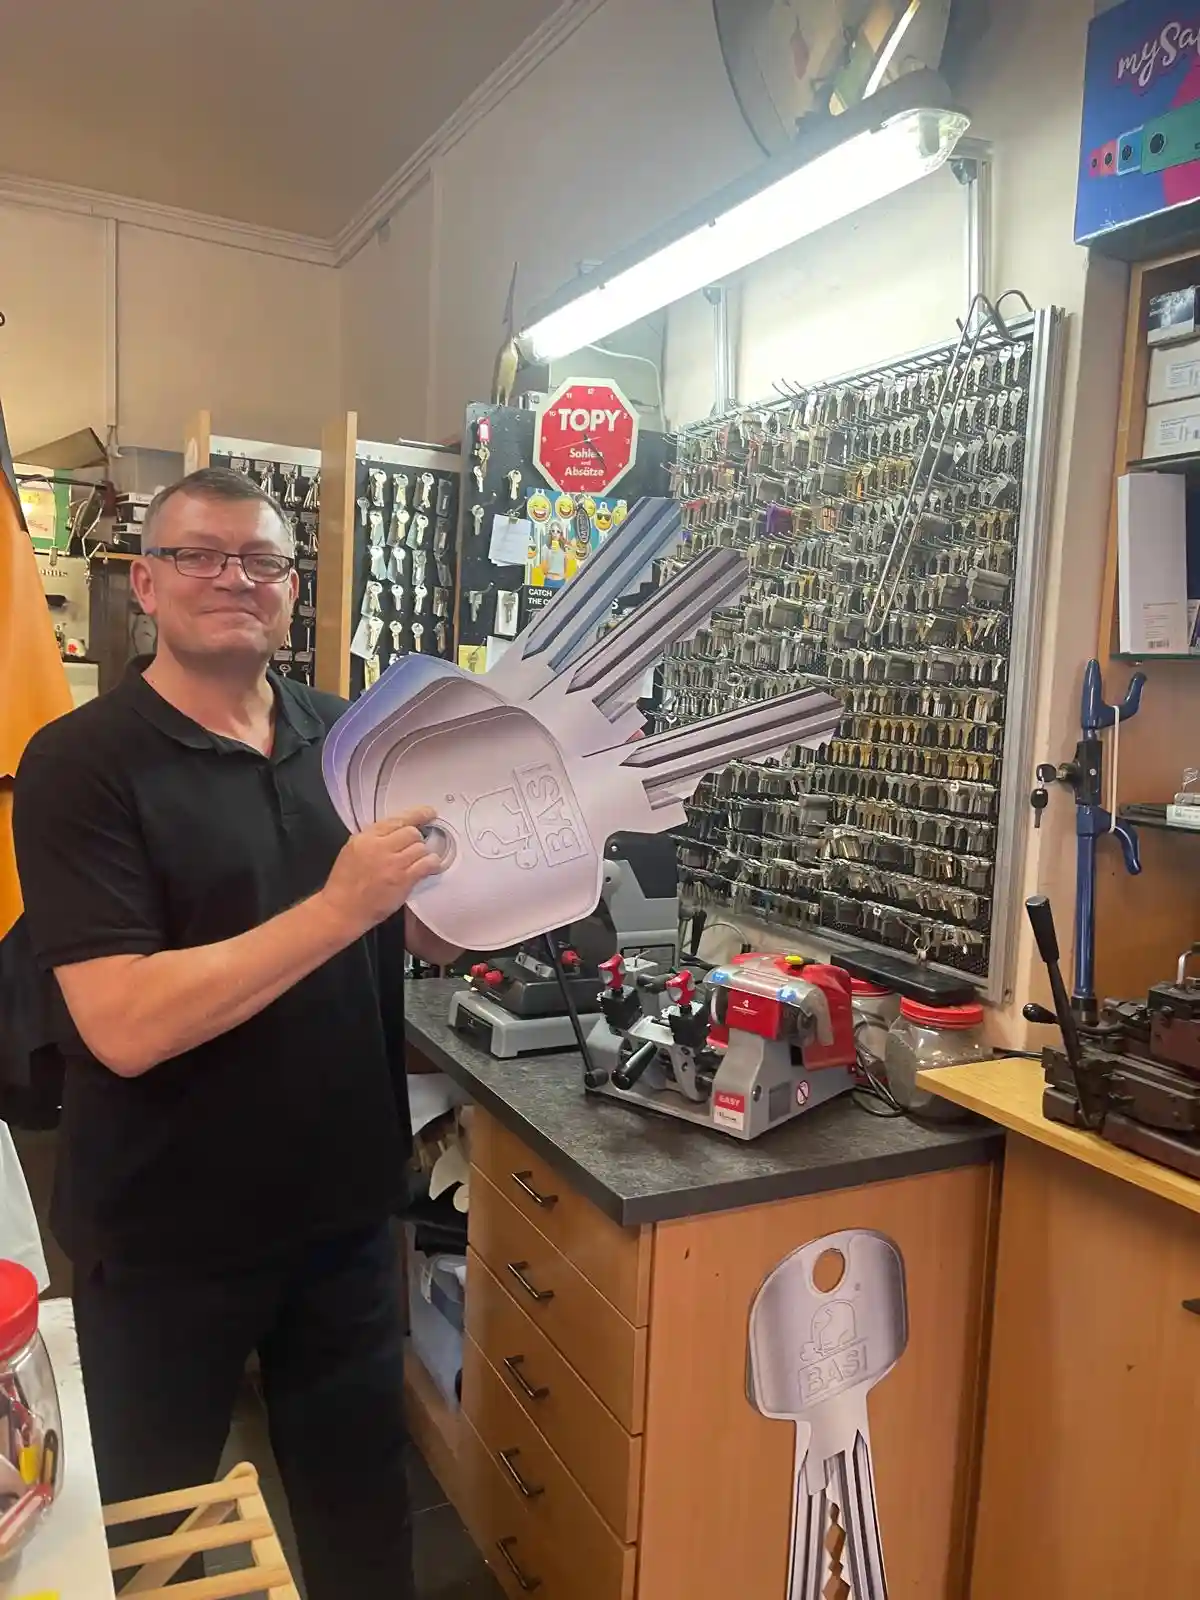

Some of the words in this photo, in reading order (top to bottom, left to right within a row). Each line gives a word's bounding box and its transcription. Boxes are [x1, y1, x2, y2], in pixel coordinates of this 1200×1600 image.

[558, 408, 621, 432] TOPY
[564, 466, 605, 477] Absätze
[528, 588, 553, 597] CATCH
[528, 597, 542, 605] THE
[519, 762, 585, 859] BASI
[803, 1344, 868, 1396] BASI
